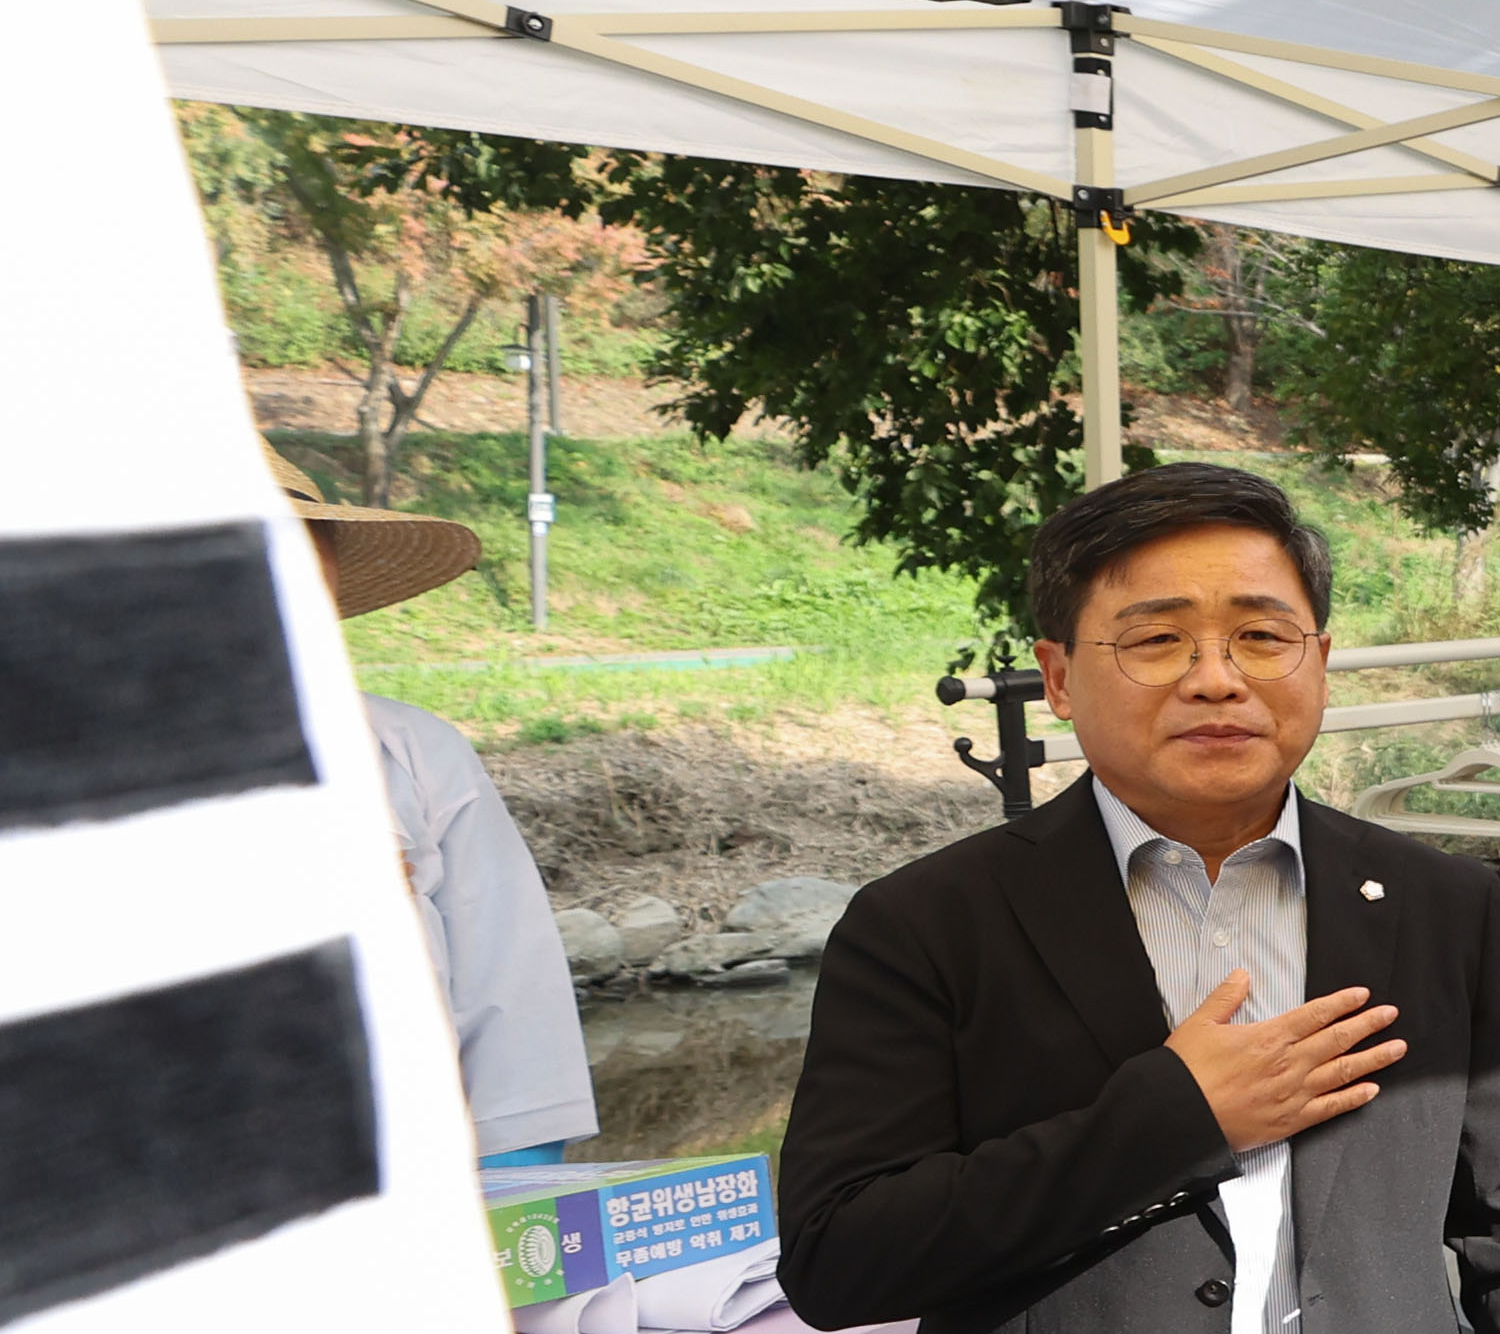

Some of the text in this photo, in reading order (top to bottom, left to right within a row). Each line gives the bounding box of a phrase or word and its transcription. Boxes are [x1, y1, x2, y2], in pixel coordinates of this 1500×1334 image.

[606, 1169, 758, 1228] 항균위생남장화
[561, 1232, 582, 1255] 생
[615, 1239, 683, 1268] 무좀예방
[729, 1221, 762, 1243] 제거
